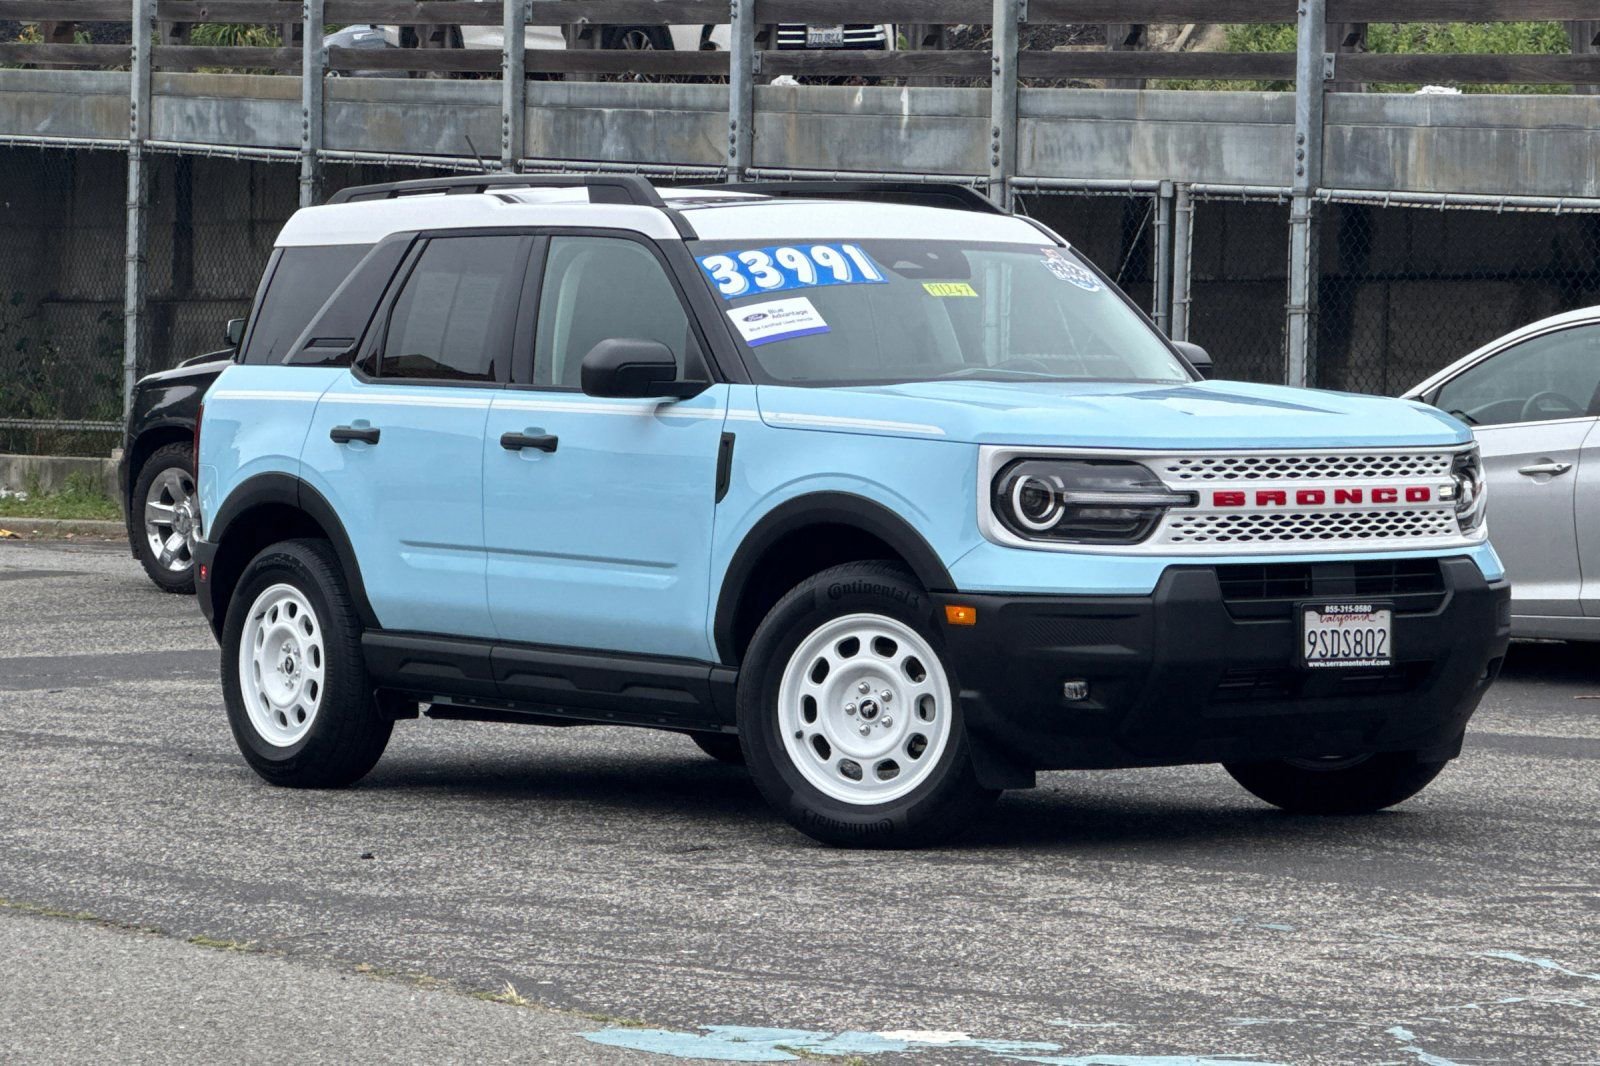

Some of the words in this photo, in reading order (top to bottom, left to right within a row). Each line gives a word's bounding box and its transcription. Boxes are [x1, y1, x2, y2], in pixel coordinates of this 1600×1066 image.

[701, 244, 883, 296] 33991
[772, 310, 808, 319] Advantage
[1212, 486, 1431, 507] BRONCO
[827, 579, 910, 603] Continental
[1325, 605, 1372, 613] 855-315-9580
[1320, 613, 1376, 626] California
[1307, 628, 1386, 658] 9SDS802
[1308, 659, 1390, 667] www.serramonteford.com
